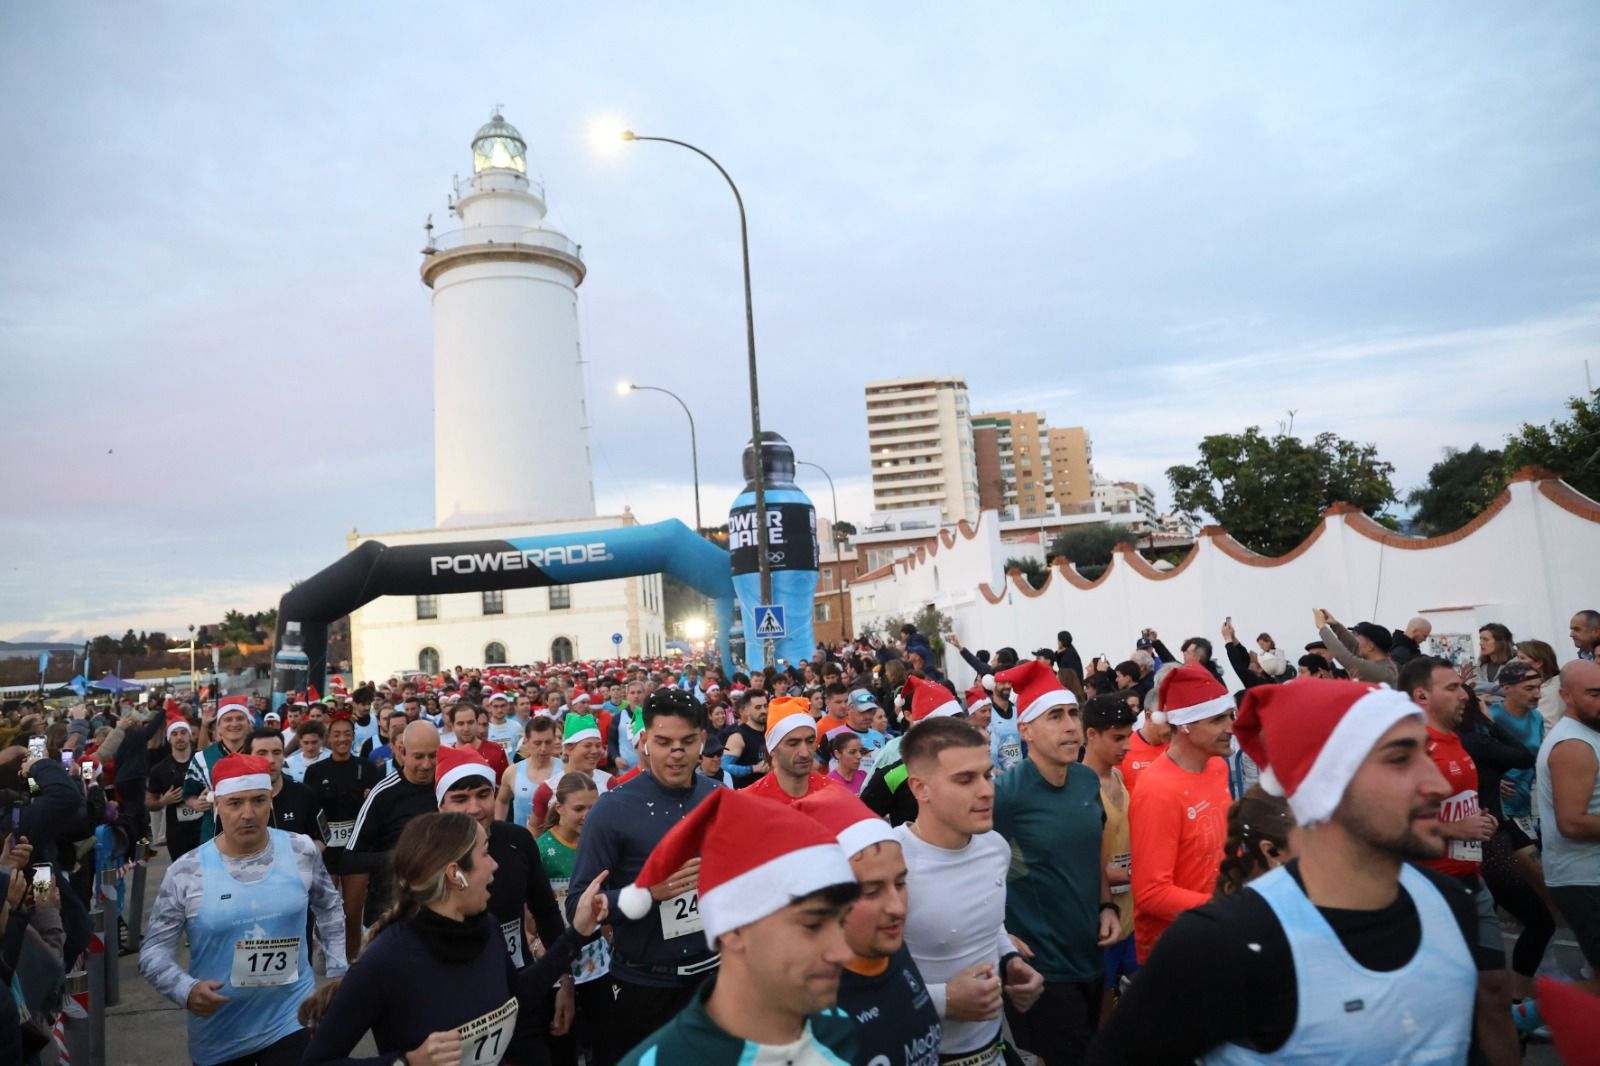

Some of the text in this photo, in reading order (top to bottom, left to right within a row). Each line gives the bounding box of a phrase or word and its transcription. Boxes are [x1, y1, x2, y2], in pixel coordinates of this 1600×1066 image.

[430, 541, 607, 576] POWERADE
[247, 951, 288, 973] 173
[470, 1018, 487, 1029] SAN
[474, 1027, 503, 1061] 77
